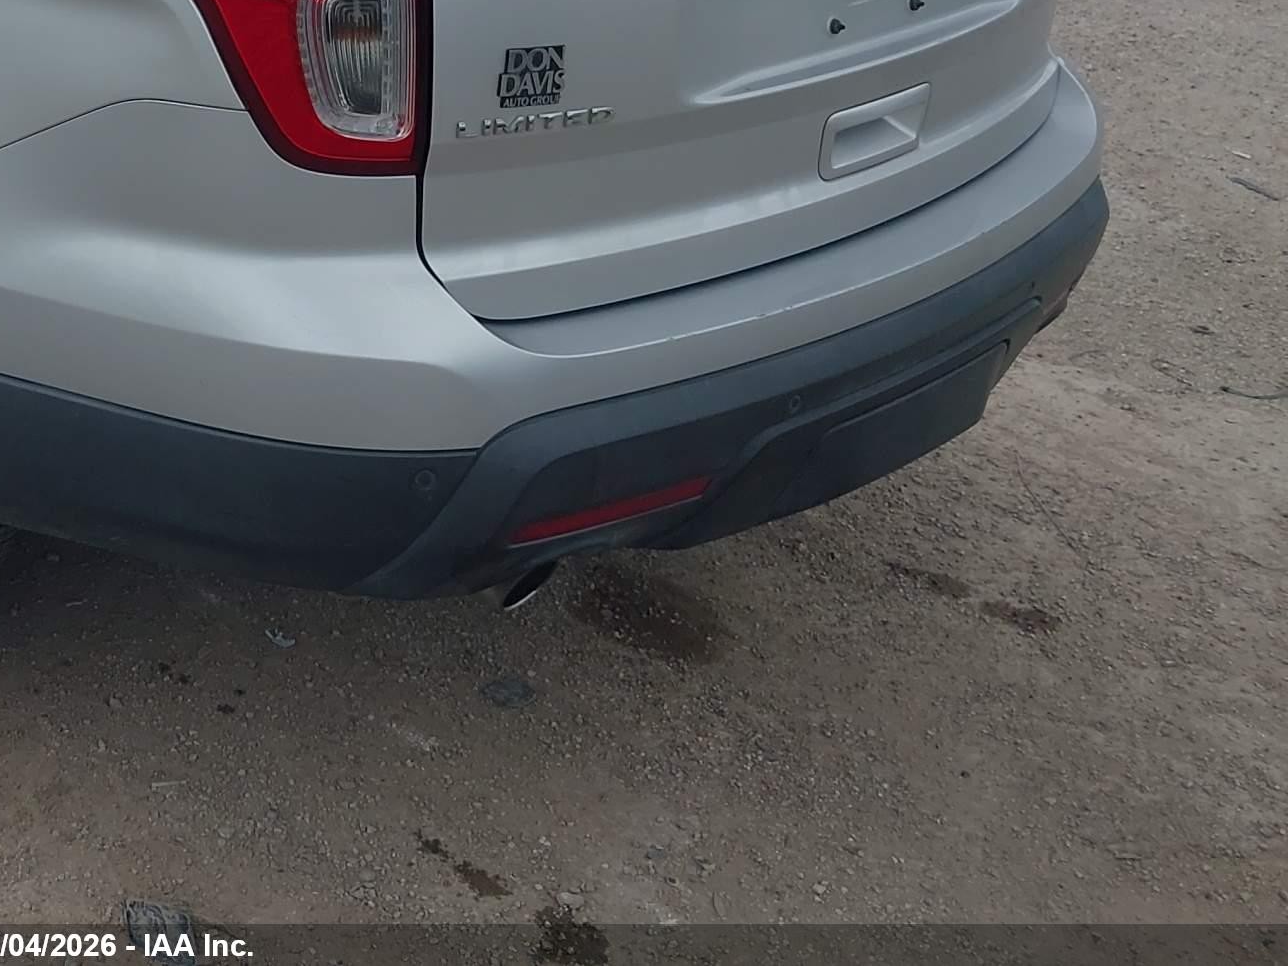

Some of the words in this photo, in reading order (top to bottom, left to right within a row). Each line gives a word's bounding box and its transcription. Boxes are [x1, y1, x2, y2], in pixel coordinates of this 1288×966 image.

[507, 47, 564, 73] DON
[500, 70, 565, 97] DAVIS
[502, 98, 529, 108] AUTO
[455, 106, 614, 138] LIMITED
